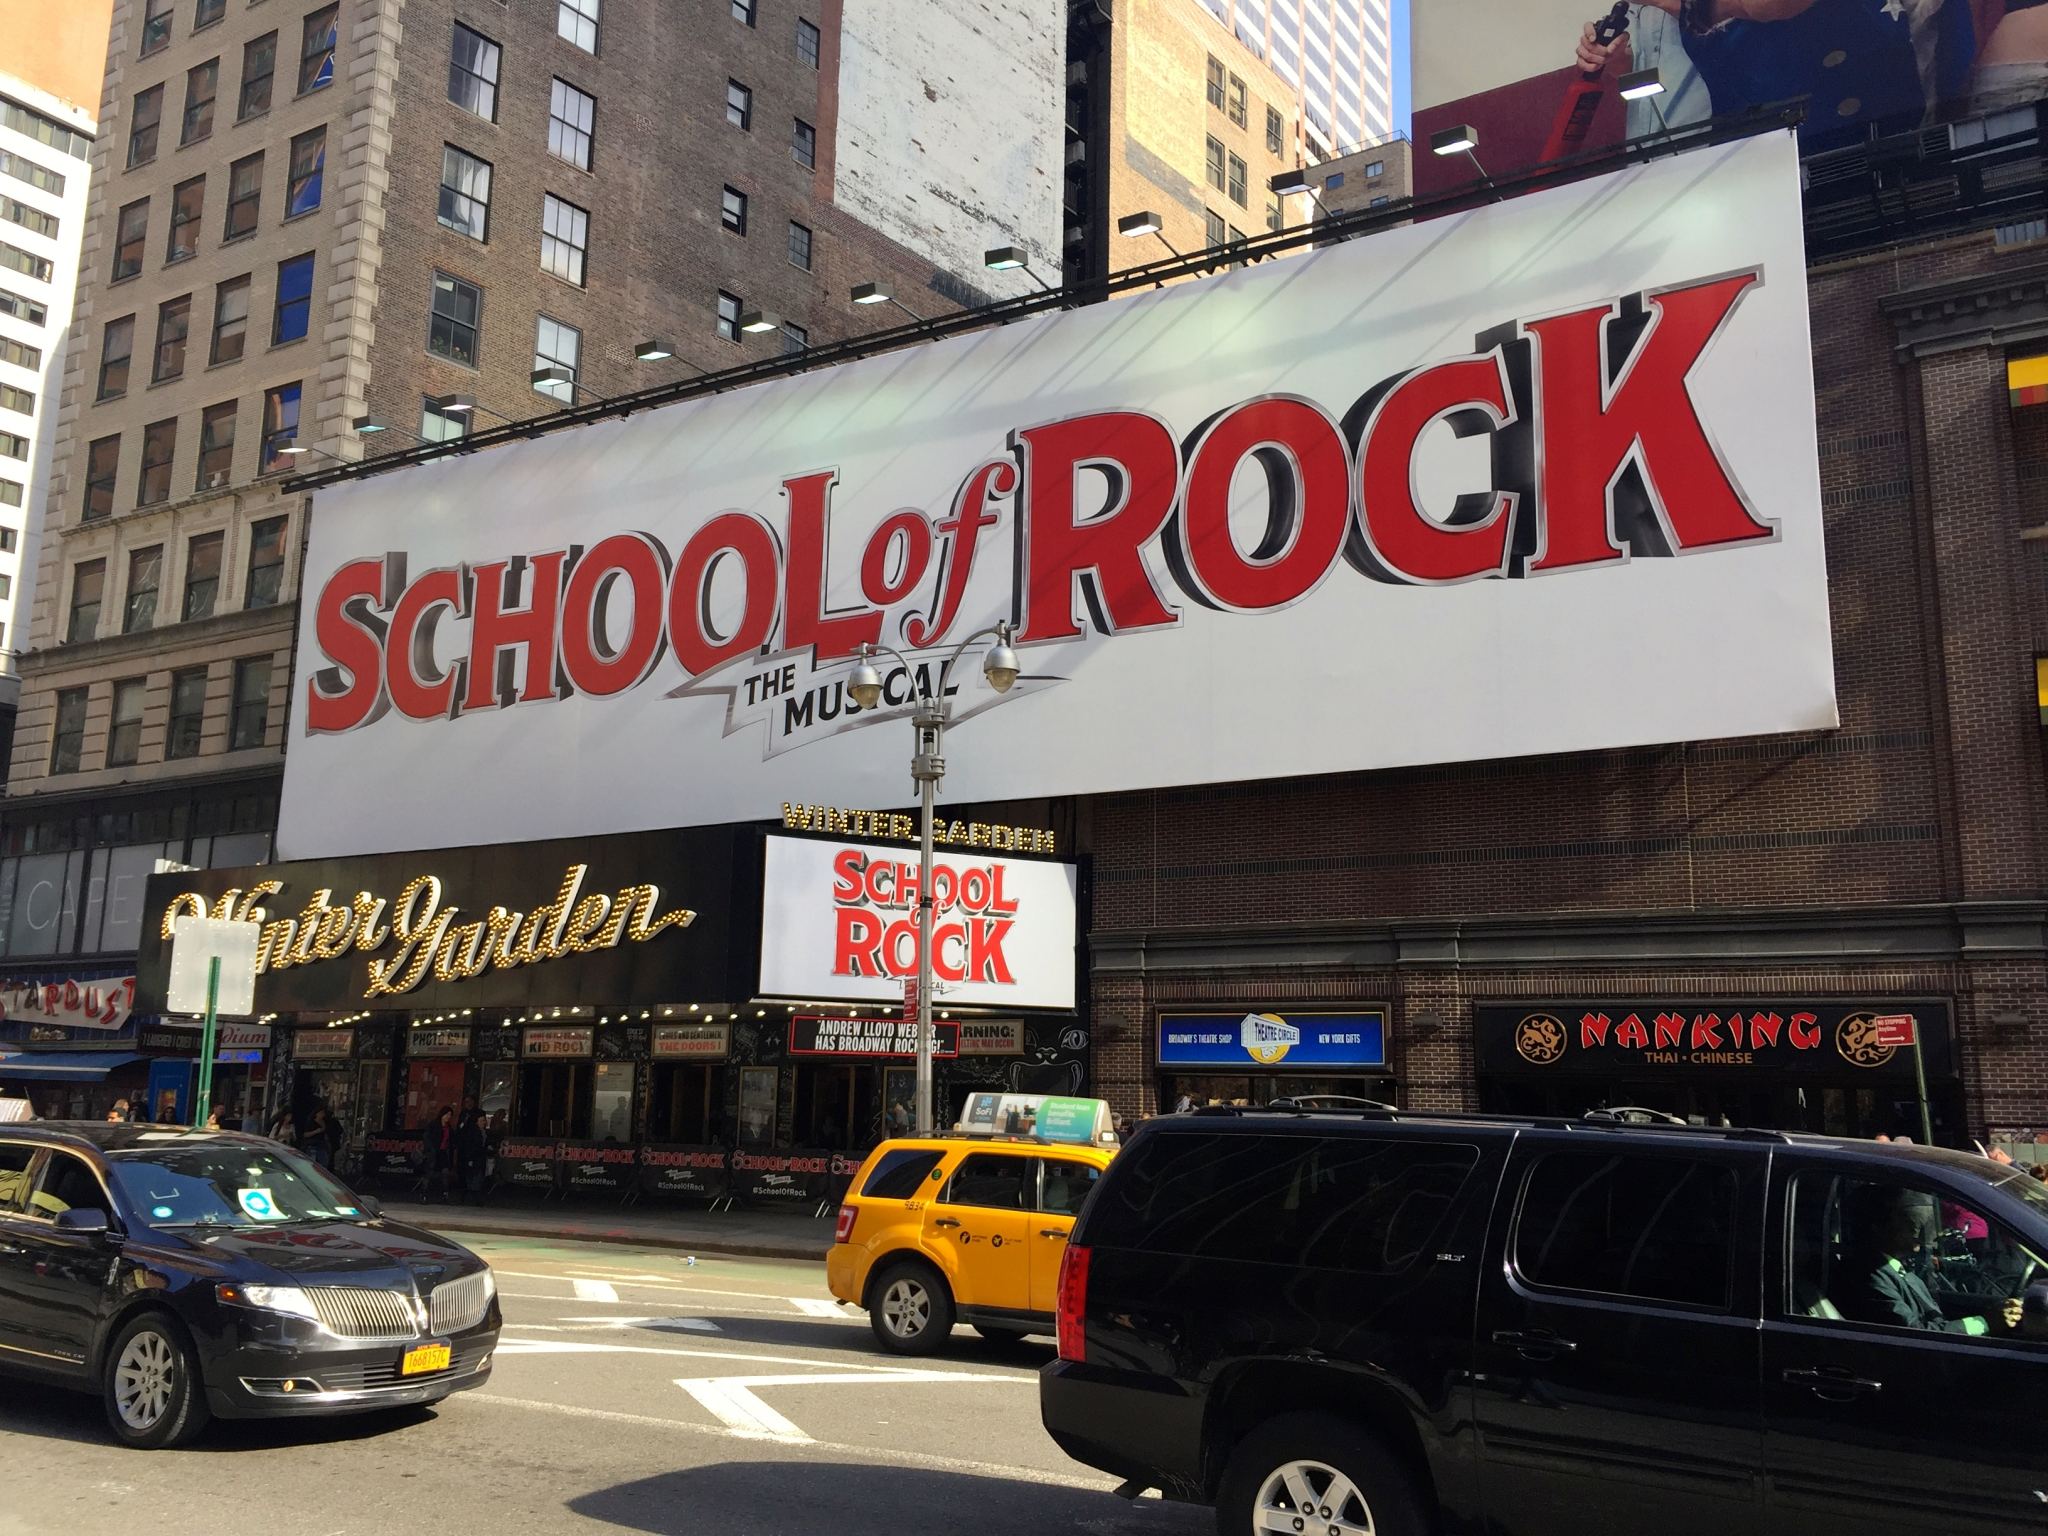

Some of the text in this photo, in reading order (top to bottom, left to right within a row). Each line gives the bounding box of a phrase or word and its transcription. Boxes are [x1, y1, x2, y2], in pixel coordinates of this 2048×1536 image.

[305, 264, 1782, 737] SCHOOL of ROCK
[744, 663, 796, 706] THE
[783, 660, 960, 736] MUCAL
[782, 802, 1054, 853] WINTER GARDEN
[832, 848, 1019, 917] SCHOOL
[363, 863, 697, 998] Garden
[831, 906, 1018, 985] ROCK
[865, 1022, 894, 1037] LLOYD
[898, 1023, 937, 1039] WEBR
[959, 1026, 1015, 1038] RNING:
[1219, 1034, 1232, 1044] SHOP
[1254, 1022, 1297, 1042] THEATRE CIRCLE
[1318, 1034, 1361, 1044] NEW YORK GIFTS
[1579, 1011, 1822, 1050] NANKING
[529, 1041, 549, 1053] KID
[658, 1041, 679, 1051] THE
[815, 1037, 836, 1051] HAS
[839, 1038, 892, 1052] BROADWAY
[1644, 1051, 1753, 1065] THAI CHINESE
[975, 1107, 993, 1116] SoFi
[640, 1146, 687, 1167] SCHOOL
[732, 1149, 785, 1171] SCHOOL
[789, 1157, 829, 1173] ROCK
